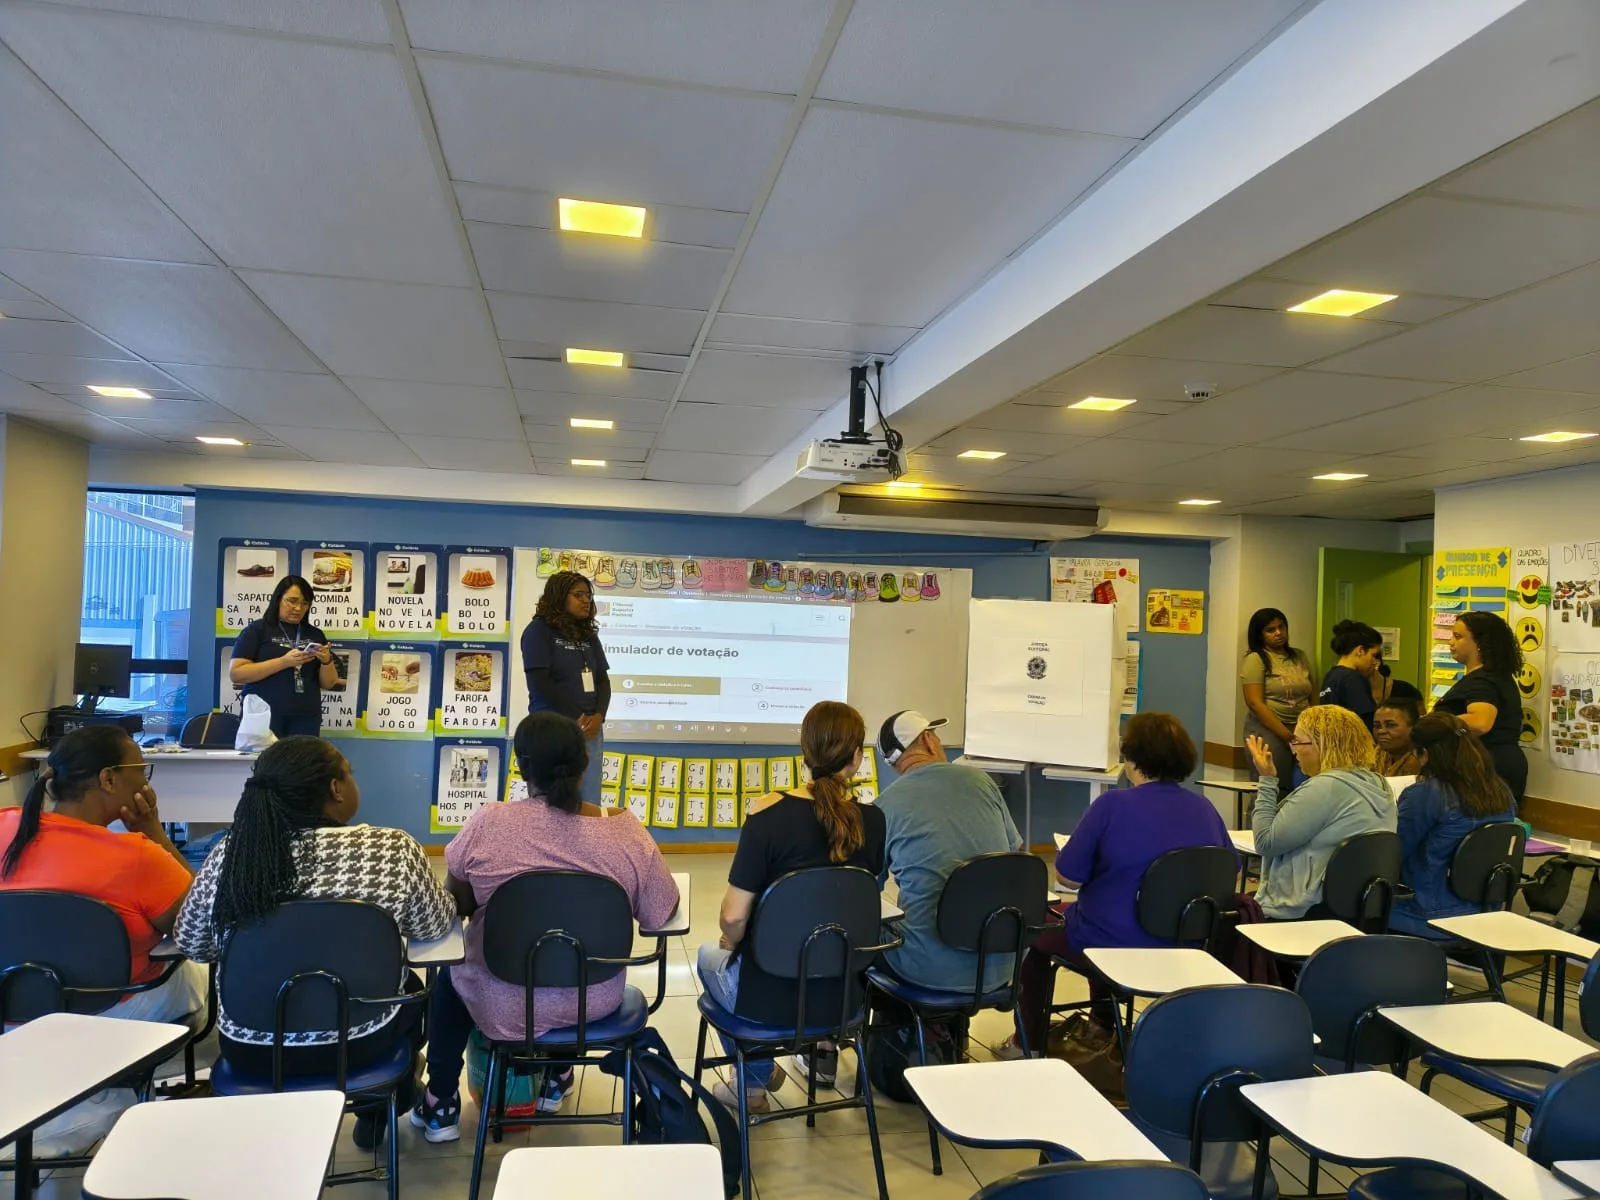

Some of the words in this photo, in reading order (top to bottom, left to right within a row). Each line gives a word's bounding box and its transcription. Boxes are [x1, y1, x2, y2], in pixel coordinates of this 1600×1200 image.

[1446, 552, 1478, 562] QUADRO
[1480, 552, 1490, 562] DE
[1518, 549, 1542, 557] QUADRO
[1446, 564, 1497, 578] PRESENÇA
[238, 593, 272, 602] SAPATO
[314, 594, 350, 603] COMIDA
[388, 597, 424, 605] NOVELA
[465, 598, 490, 607] BOLO
[227, 604, 239, 614] SA
[250, 605, 260, 614] PA
[311, 606, 317, 614] O
[347, 608, 358, 616] DA
[379, 608, 392, 616] NO
[402, 608, 412, 616] VE
[422, 609, 432, 617] LA
[458, 610, 472, 618] BO
[605, 644, 663, 655] imulador
[667, 646, 683, 655] de
[687, 647, 739, 659] votação
[1562, 672, 1600, 687] SAUDÁVE
[322, 694, 342, 703] ZINA
[386, 696, 411, 705] JOGO
[456, 694, 488, 702] FAROFA
[224, 702, 233, 713] XÍ
[340, 707, 352, 715] NA
[378, 708, 390, 716] JO
[404, 708, 417, 716] GO
[445, 705, 456, 713] FA
[448, 790, 488, 798] HOSPITAL
